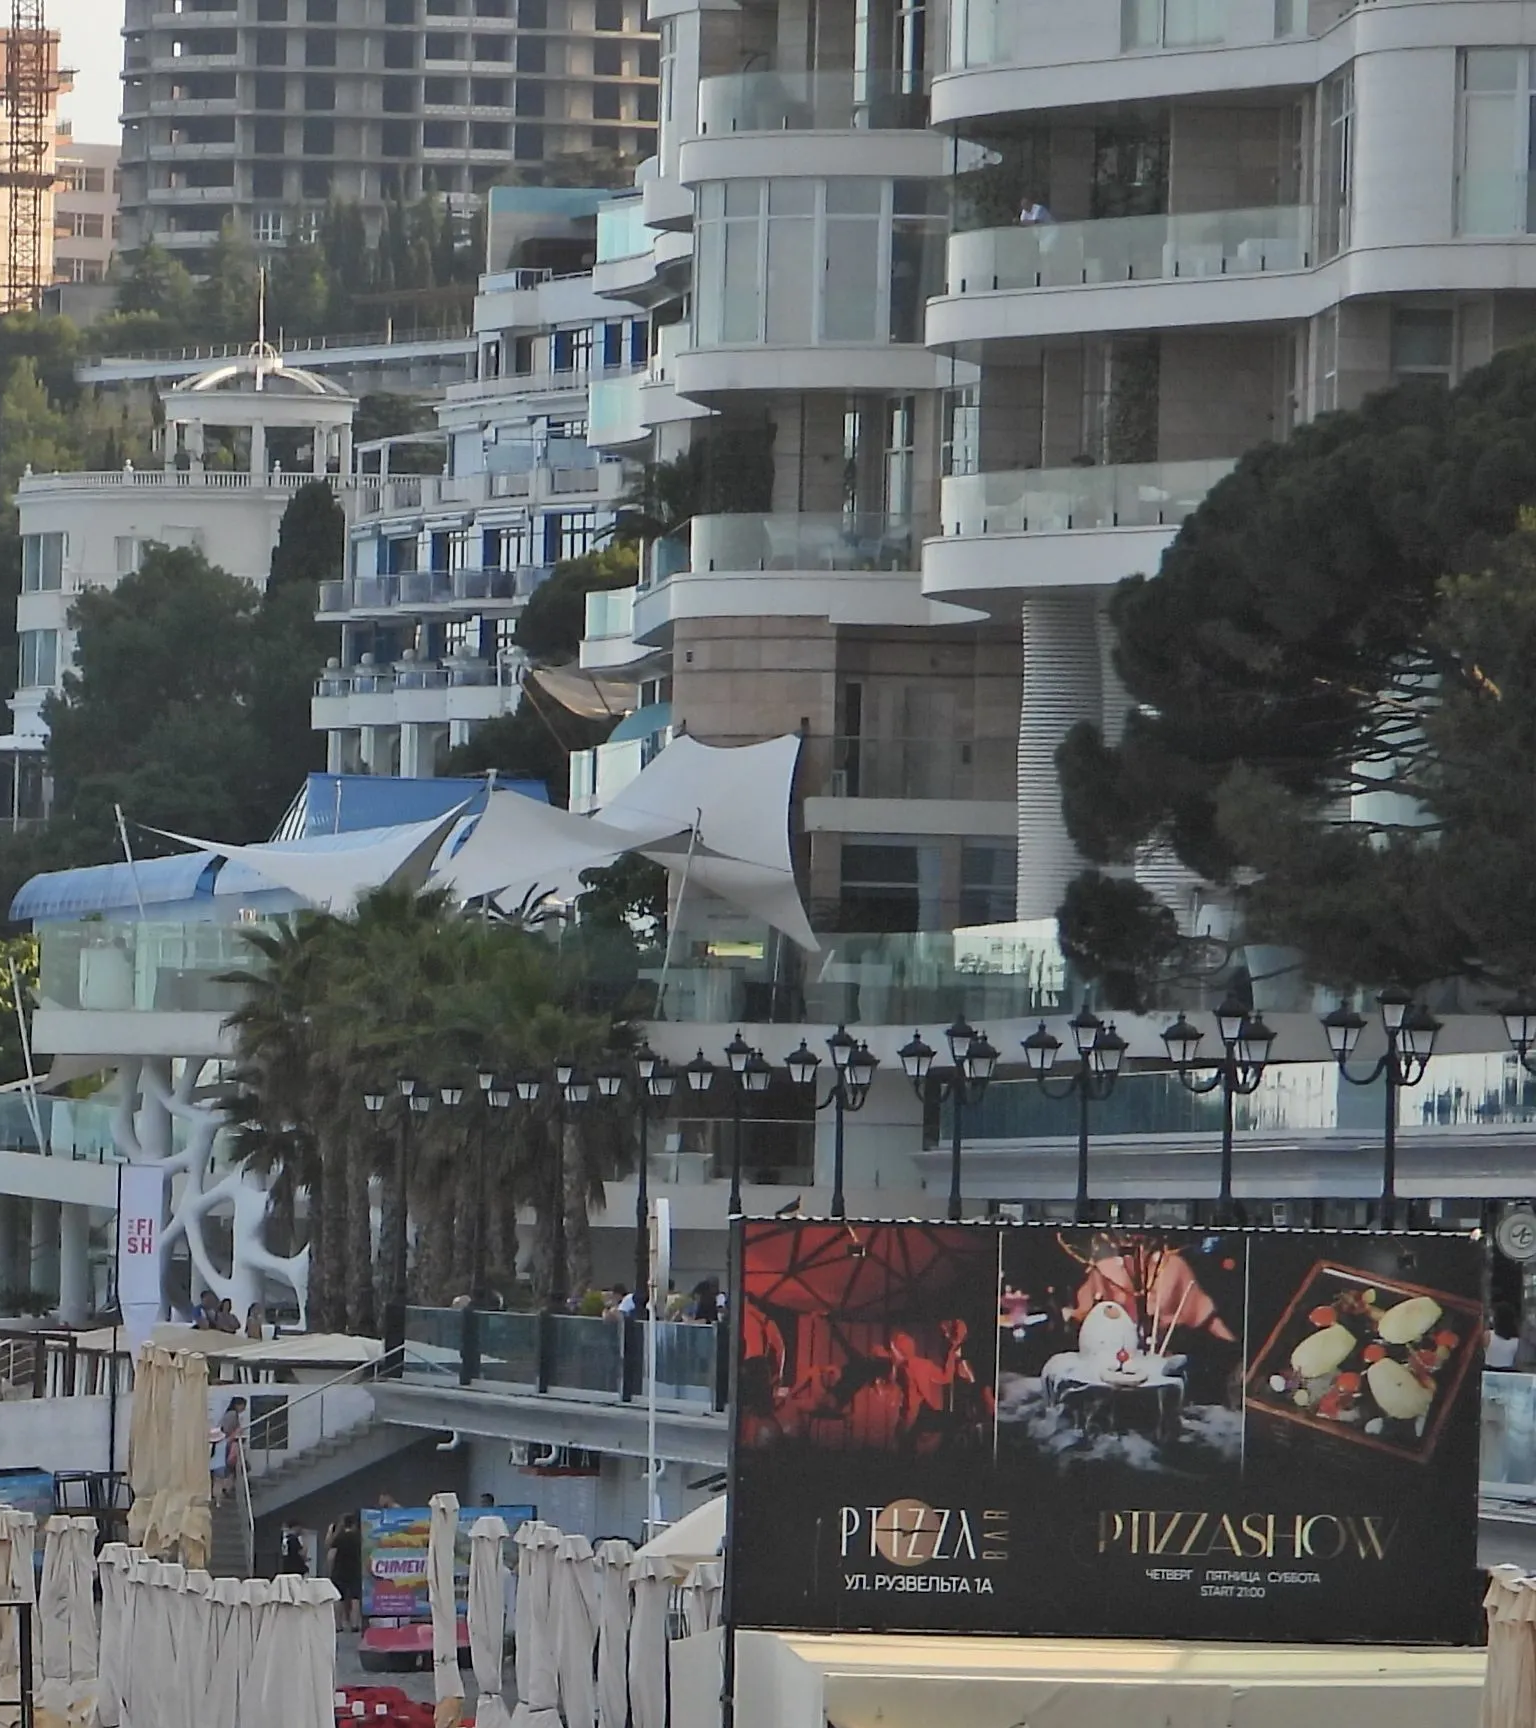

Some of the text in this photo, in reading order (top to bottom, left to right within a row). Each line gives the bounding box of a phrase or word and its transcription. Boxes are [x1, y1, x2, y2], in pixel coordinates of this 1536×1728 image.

[841, 1506, 976, 1560] PTIZZA
[376, 1559, 425, 1573] СИМЕИ
[844, 1574, 870, 1591] УЛ.
[875, 1575, 971, 1594] РУЗВЕЛЬТА
[1145, 1569, 1320, 1584] ЧЕТВЕРГ ПЯТНИЦА СУББОТА
[1200, 1585, 1266, 1598] START 21:00
